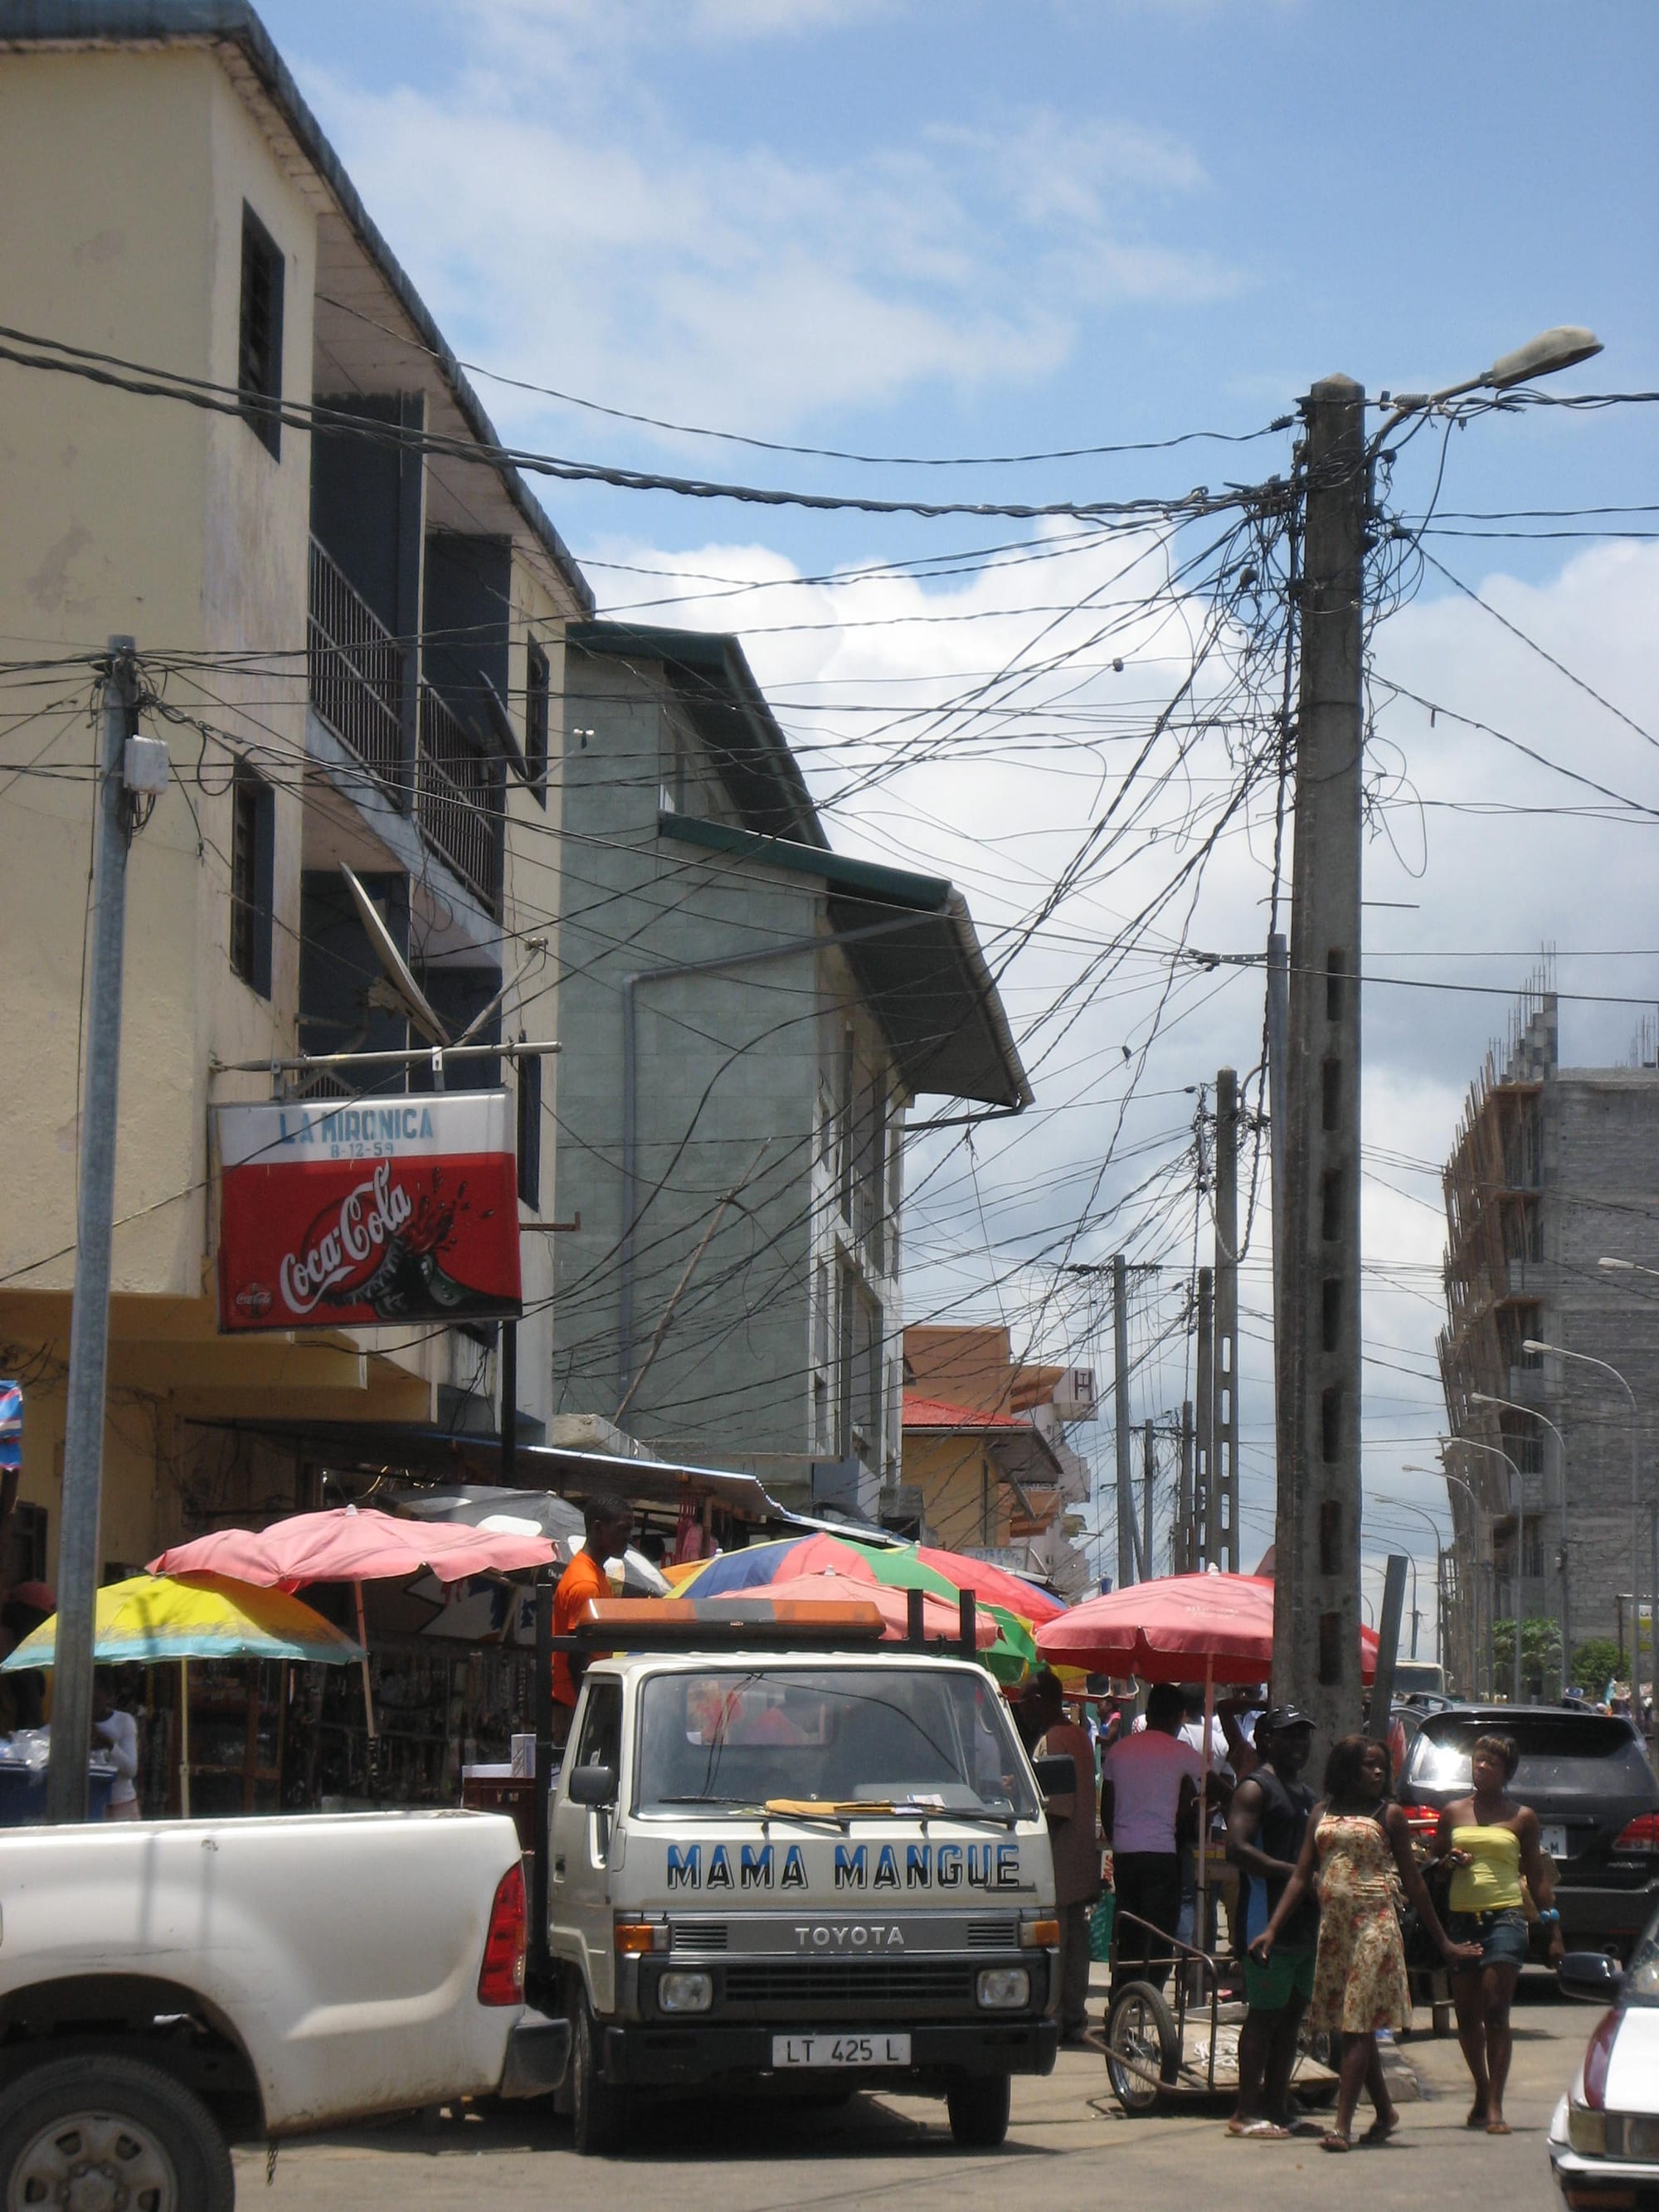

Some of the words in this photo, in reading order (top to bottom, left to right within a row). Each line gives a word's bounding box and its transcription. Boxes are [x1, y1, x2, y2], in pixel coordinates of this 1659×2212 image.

[279, 1112, 314, 1145] LA
[280, 1159, 411, 1315] Coca-Cola
[667, 1844, 809, 1890] MAMA
[834, 1844, 1020, 1890] MANGUE
[795, 1926, 905, 1946] TOYOTA
[786, 2039, 815, 2063] LT
[831, 2039, 873, 2063] 425
[886, 2039, 900, 2062] L
